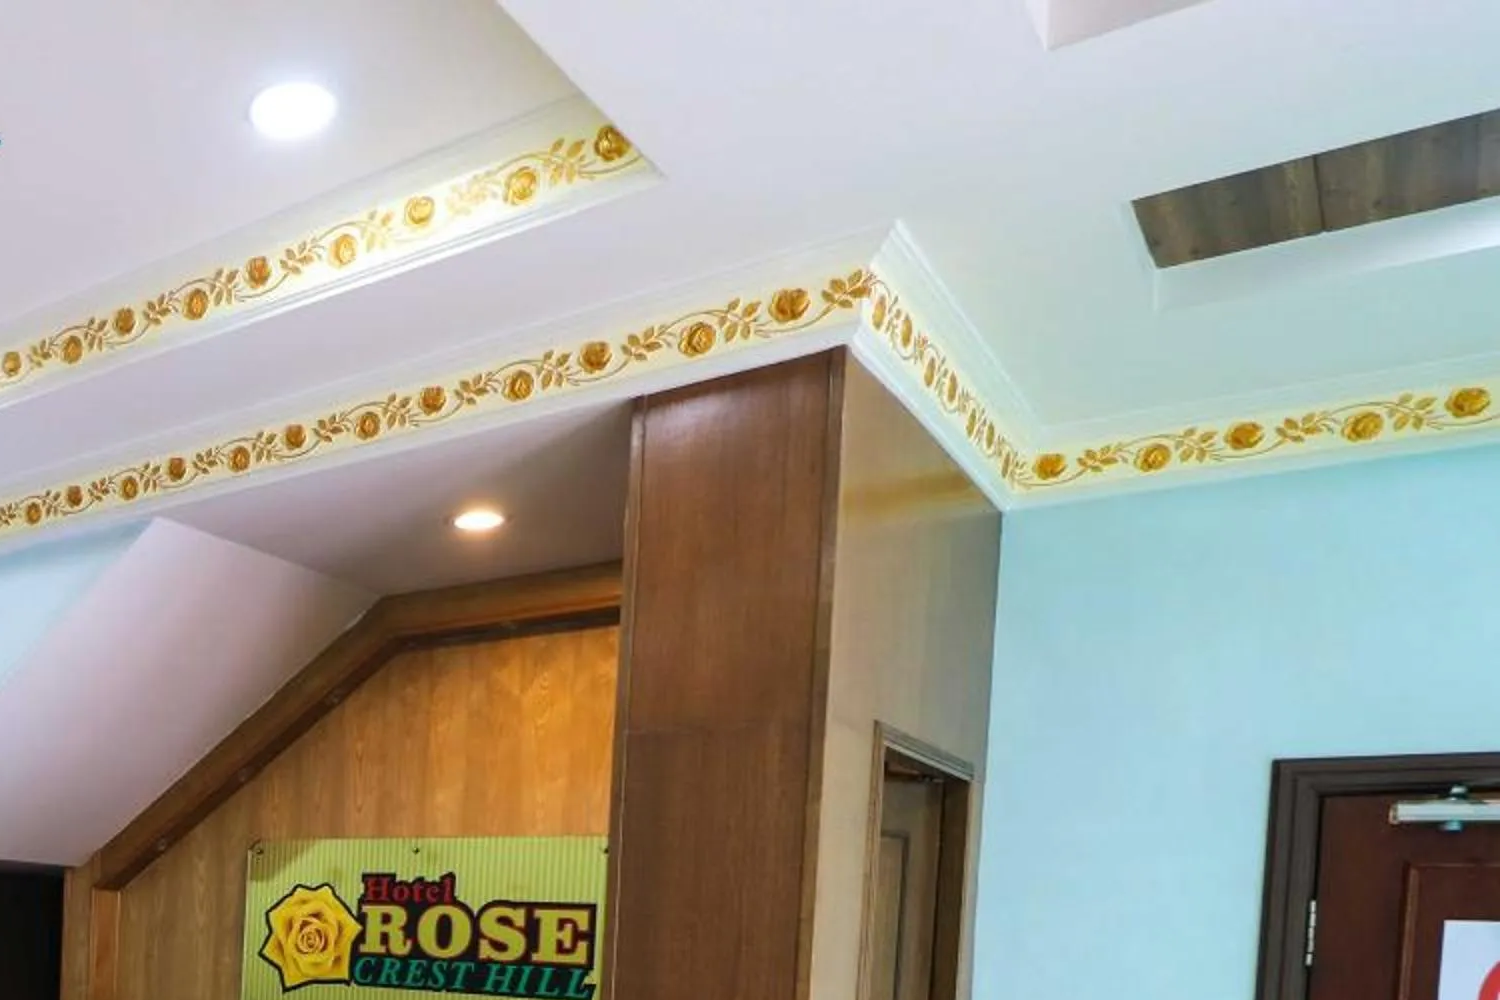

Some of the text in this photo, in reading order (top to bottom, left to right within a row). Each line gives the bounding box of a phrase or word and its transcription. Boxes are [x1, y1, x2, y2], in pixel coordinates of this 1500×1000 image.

[364, 876, 455, 904] Hotel
[359, 903, 591, 965] ROSE
[352, 956, 593, 999] CREST HILL
